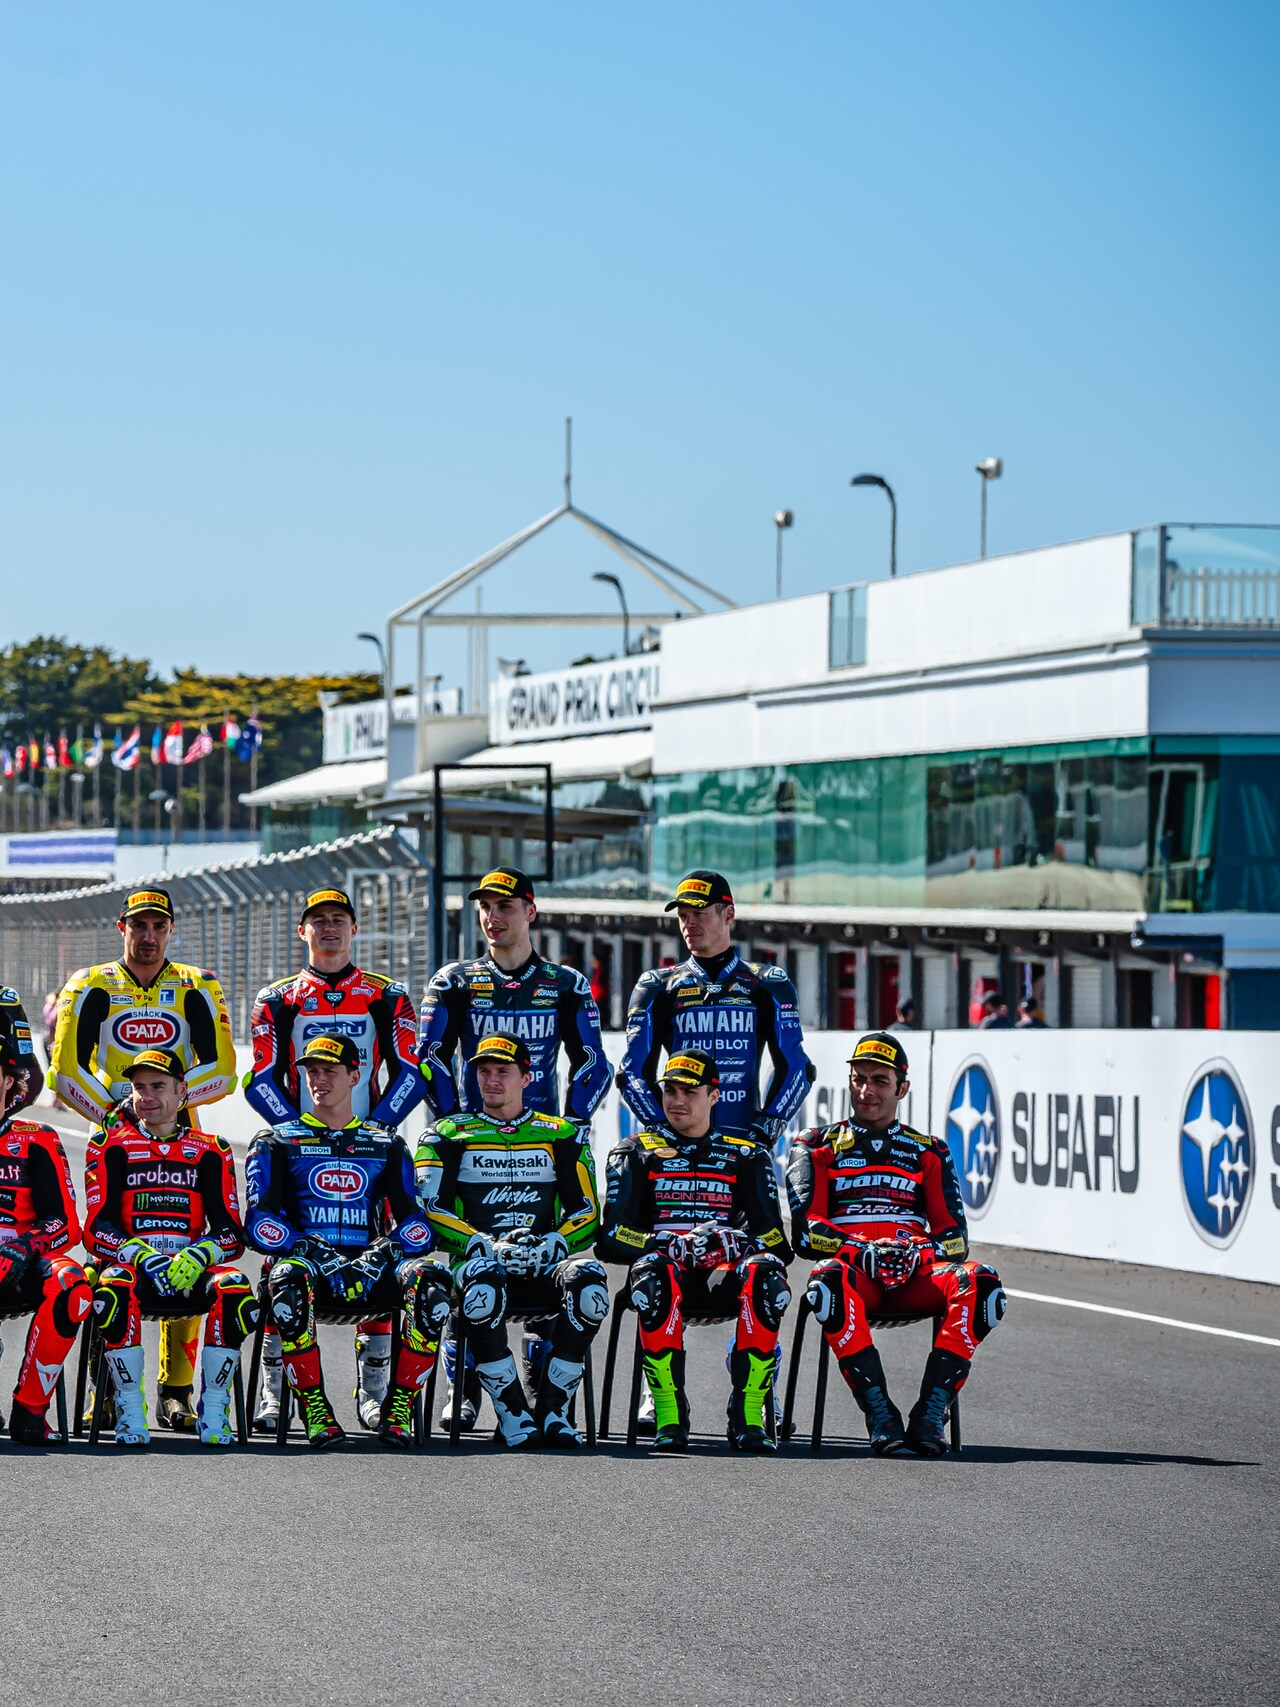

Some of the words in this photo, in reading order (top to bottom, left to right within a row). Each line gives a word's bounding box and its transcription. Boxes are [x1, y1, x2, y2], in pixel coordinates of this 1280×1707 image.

[564, 674, 602, 724] PRIX
[607, 664, 660, 718] CIRCU
[132, 1010, 161, 1018] SNACK
[471, 1014, 555, 1038] YAMAHA
[676, 1010, 754, 1033] YAMAHA
[125, 1023, 168, 1039] PATA
[693, 1039, 749, 1050] HUBLOT
[719, 1090, 747, 1102] HOP
[1012, 1091, 1140, 1194] SUBARU
[303, 1146, 330, 1154] AIROH
[326, 1162, 353, 1170] SNACK
[473, 1154, 548, 1169] Kawasaki
[839, 1159, 866, 1167] AIROH
[127, 1164, 199, 1188] aruba.it
[321, 1176, 357, 1189] PATA
[654, 1178, 732, 1194] barni
[150, 1194, 190, 1204] MONSTER
[482, 1185, 542, 1207] Ninja
[136, 1216, 188, 1230] Lenovo
[308, 1206, 368, 1226] YAMAHA
[260, 1225, 280, 1238] PATA
